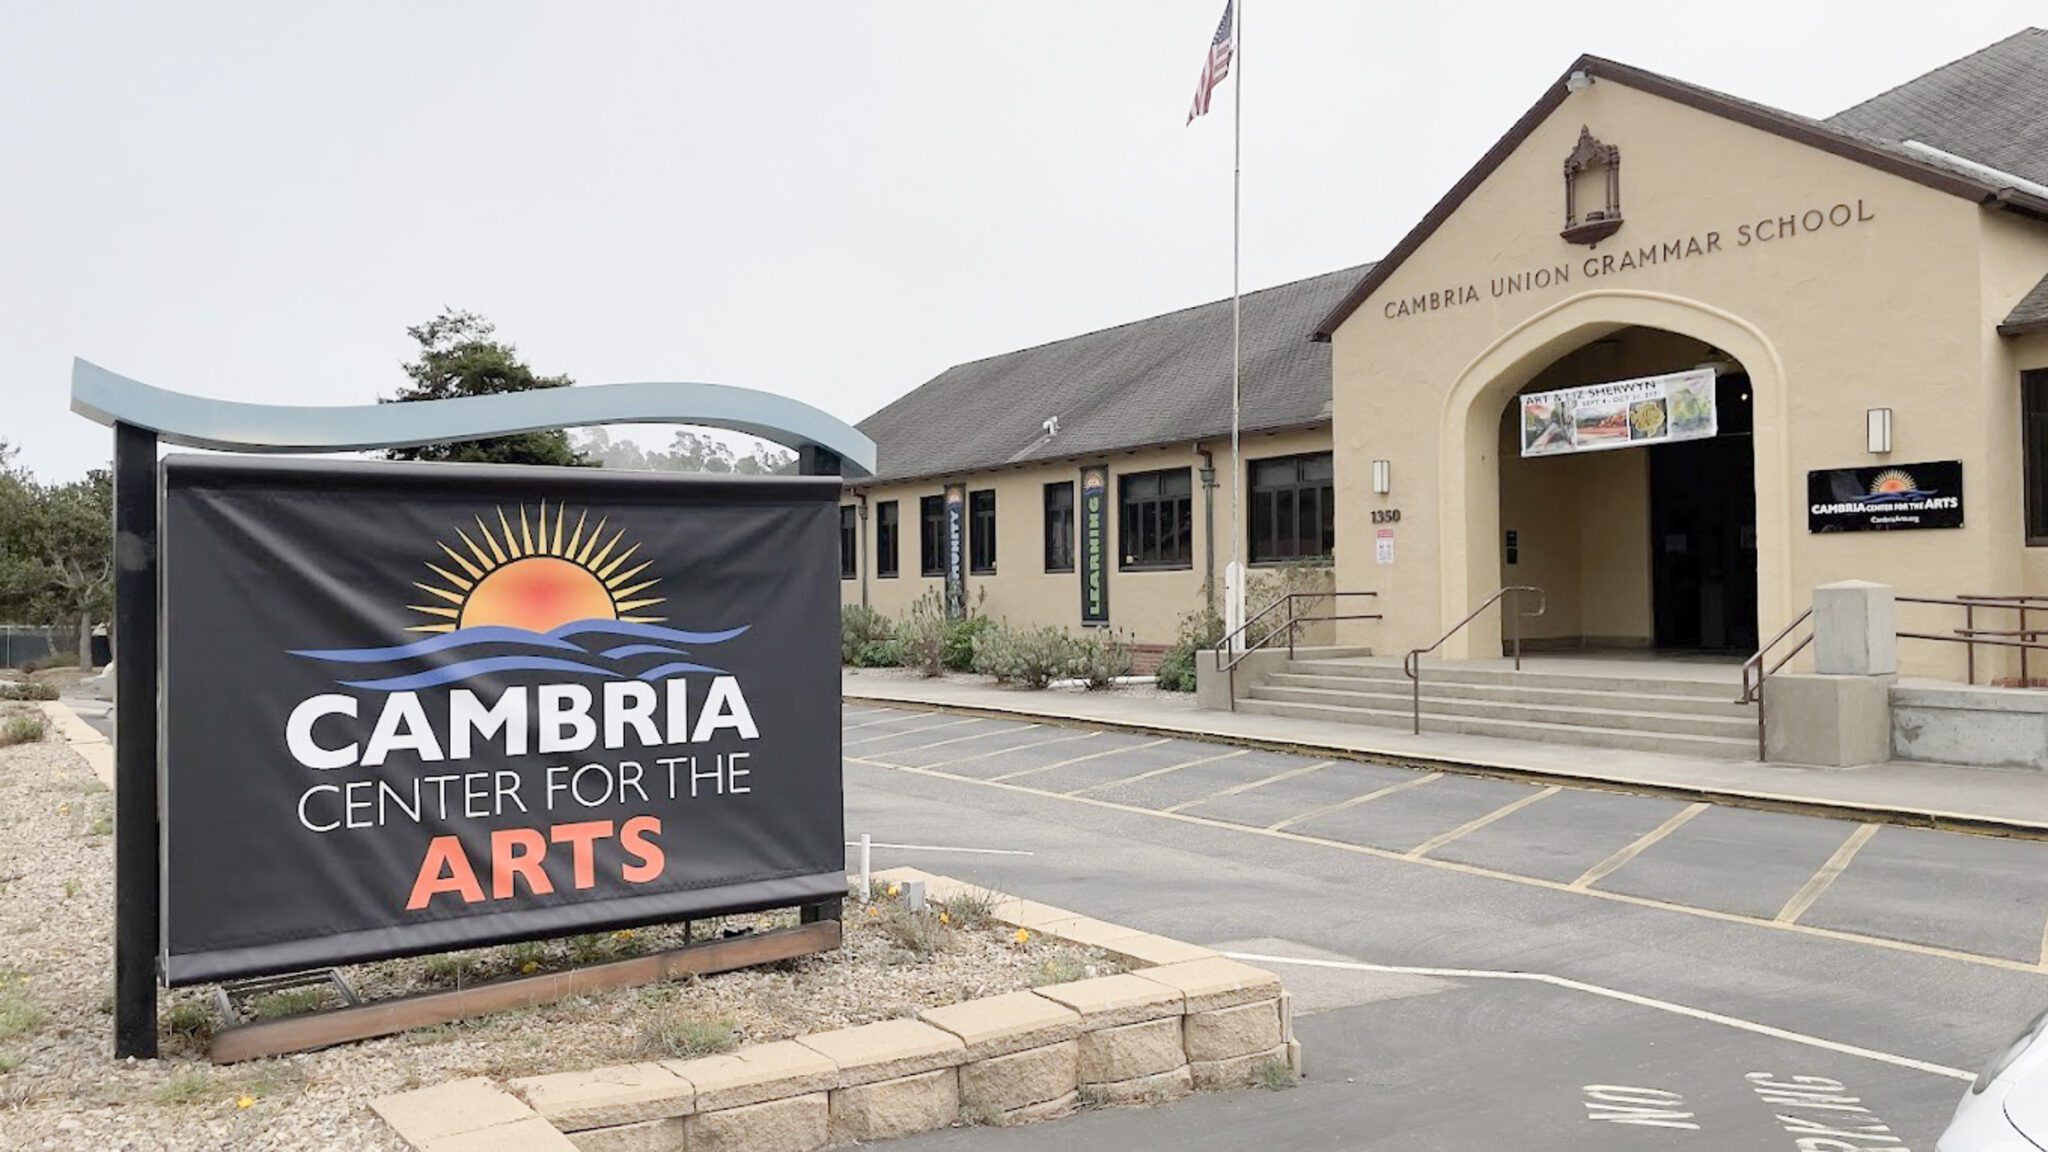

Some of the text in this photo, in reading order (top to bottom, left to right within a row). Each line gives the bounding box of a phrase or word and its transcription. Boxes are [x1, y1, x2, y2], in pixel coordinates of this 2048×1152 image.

[1384, 199, 1876, 320] CAMBRIA UNION GRAMMAR SCHOOL
[1526, 395, 1547, 405] ART
[1588, 380, 1656, 398] SHERWYN
[1371, 509, 1401, 523] 1350
[1811, 497, 1958, 514] CAMBRIA CENTER FOR THE ARTS
[1088, 496, 1100, 615] LEARNING
[286, 675, 760, 770] CAMBRIA
[298, 752, 751, 832] CENTER FOR THE
[405, 816, 666, 911] ARTS
